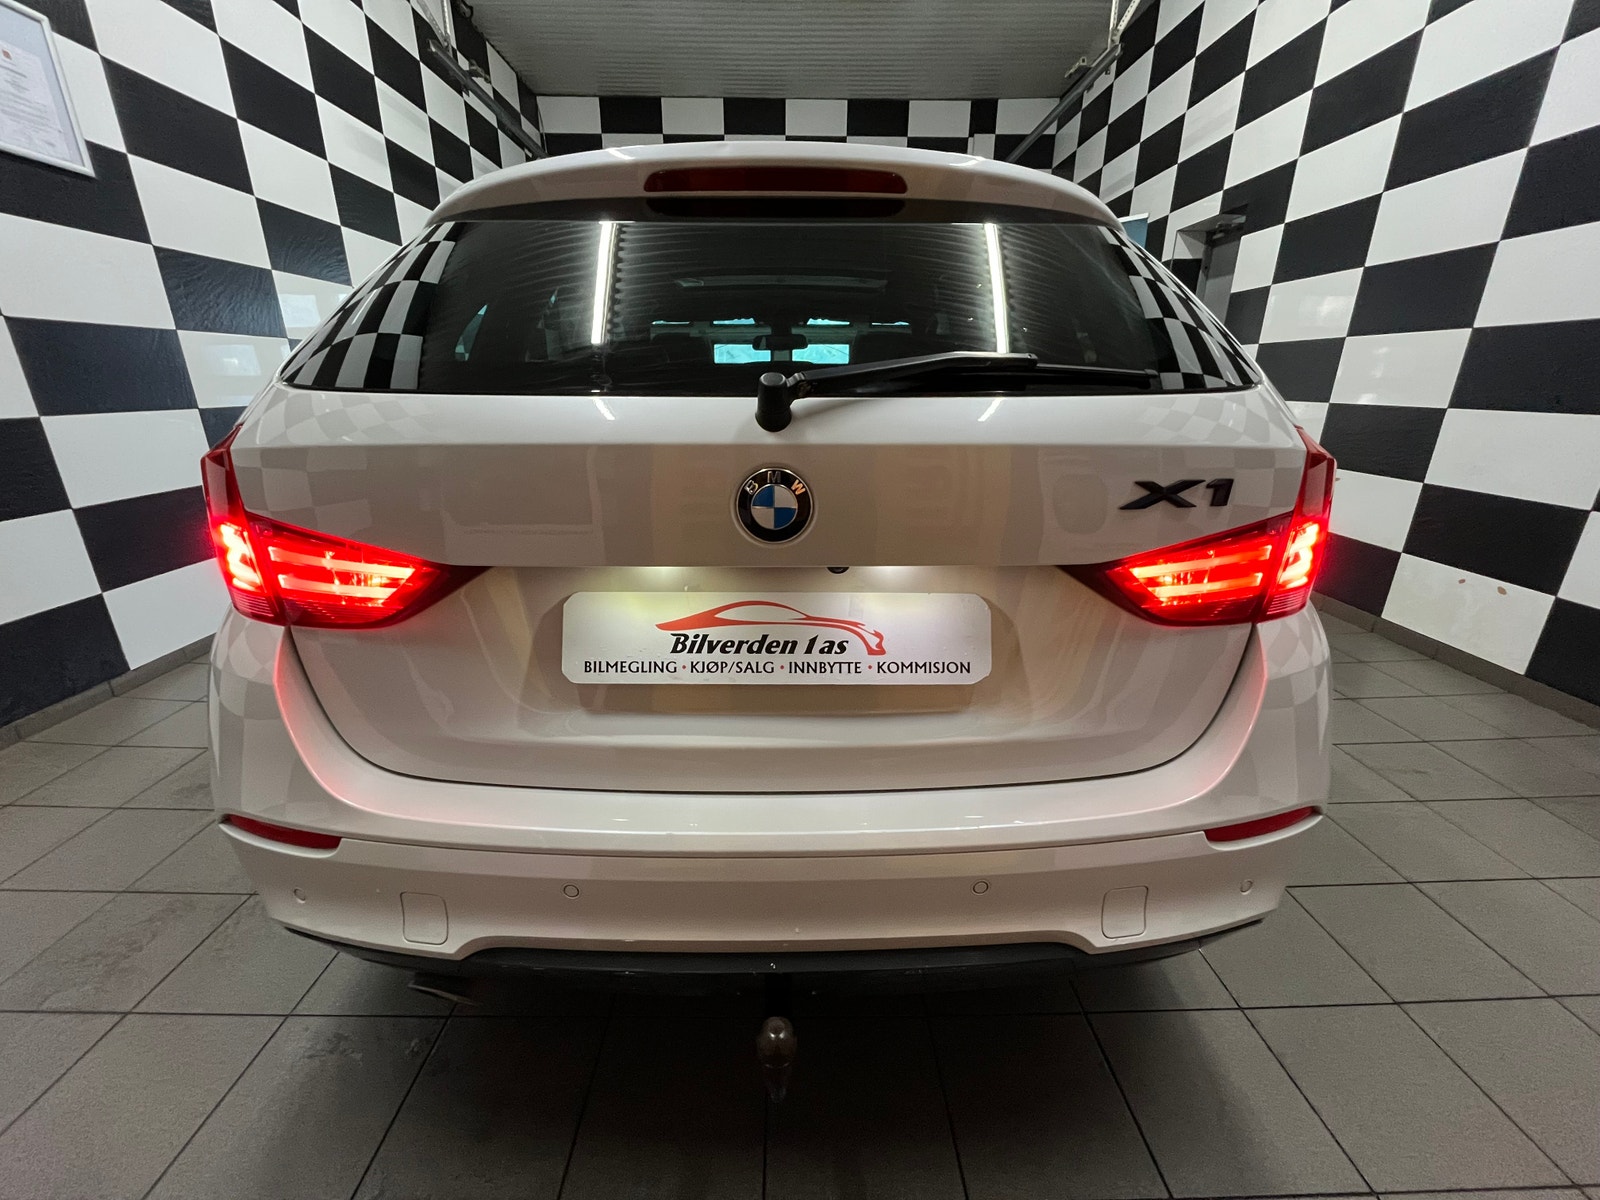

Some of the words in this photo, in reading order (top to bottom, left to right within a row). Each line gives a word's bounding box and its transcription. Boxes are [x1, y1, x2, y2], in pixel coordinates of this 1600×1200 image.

[744, 470, 806, 496] BMW
[1118, 478, 1235, 510] X1
[670, 633, 798, 655] Bilverden
[818, 640, 849, 655] as
[583, 660, 678, 674] BILMEGLING
[690, 660, 775, 674] KJØP/SALG
[788, 661, 862, 675] INNBYTTE
[876, 661, 971, 675] KOMMISJON
